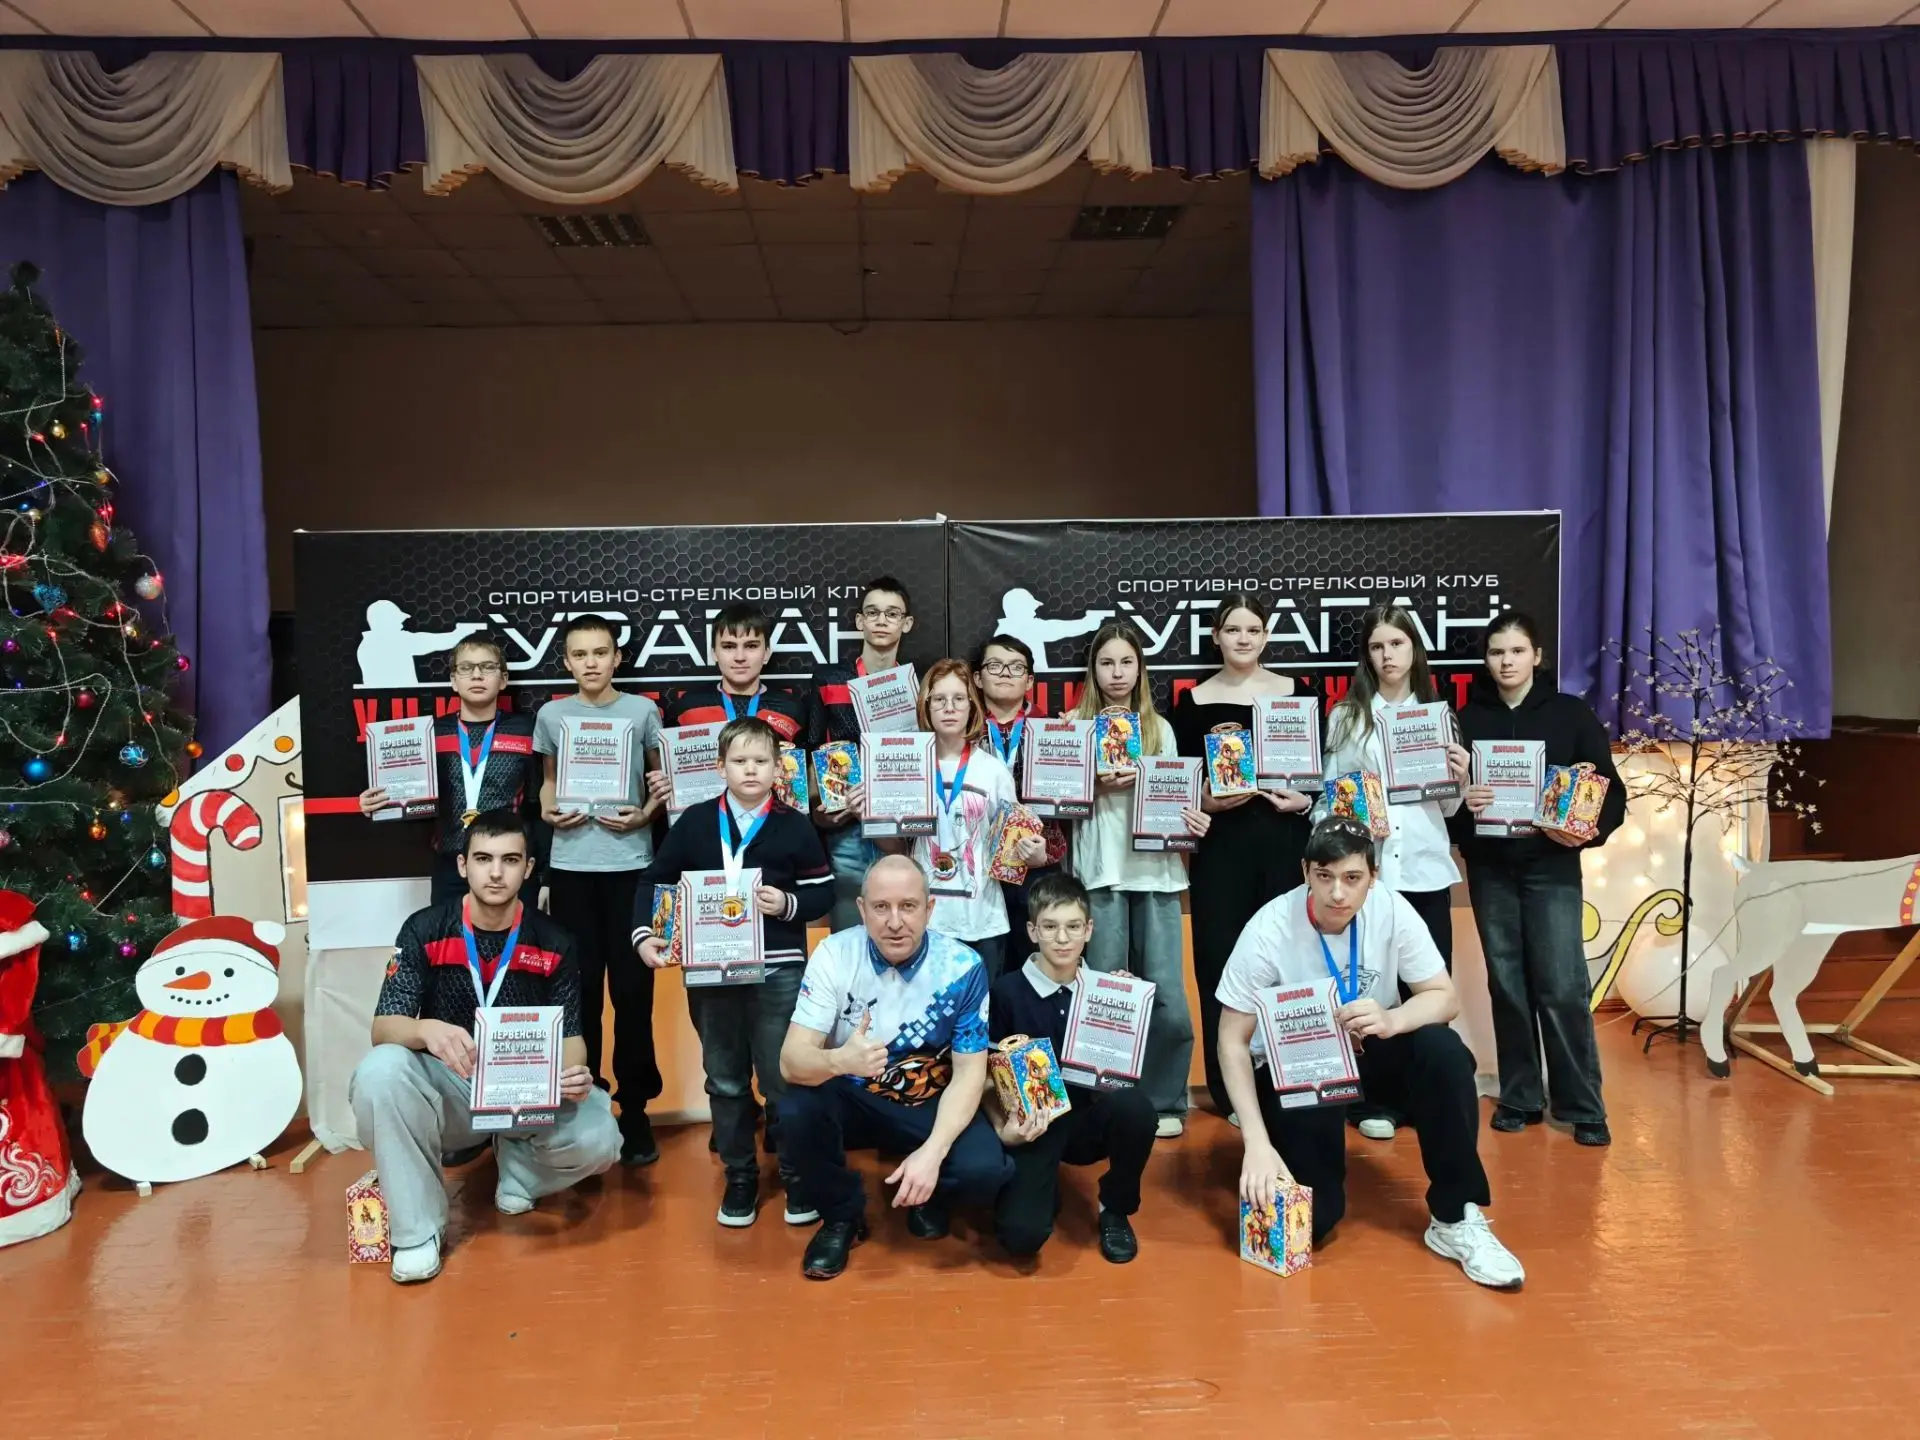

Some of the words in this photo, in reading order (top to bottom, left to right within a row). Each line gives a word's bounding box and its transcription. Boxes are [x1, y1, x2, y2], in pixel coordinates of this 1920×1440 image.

[1117, 574, 1426, 593] СПОРТИВНО-СТРЕЛКОВЫЙ
[1437, 574, 1499, 589] КЛУБ
[488, 584, 816, 606] СПОРТИВНО-СТРЕЛКОВЫЙ
[1392, 723, 1437, 735] ПЕРВЕНСТВО
[379, 737, 422, 749] ПЕРВЕНСТВО
[574, 736, 619, 747] ПЕРВЕНСТВО
[1038, 738, 1082, 747] ПЕРВЕНСТВО
[575, 746, 589, 755] ССК
[673, 742, 719, 755] ПЕРВЕНСТВО
[1040, 747, 1053, 756] ССК
[382, 750, 397, 760] ССК
[677, 754, 693, 765] ССК
[875, 751, 922, 762] ПЕРВЕНСТВО
[878, 763, 893, 772] ССК
[1487, 760, 1532, 769] ПЕРВЕНСТВО
[1148, 773, 1189, 784] ПЕРВЕНСТВО
[1488, 769, 1503, 777] ССК
[699, 903, 717, 914] ССК
[1276, 987, 1314, 1003] ДИПЛОМ
[1087, 993, 1137, 1012] ПЕРВЕНСТВО
[1087, 1003, 1104, 1016] ССК
[1273, 1003, 1327, 1021] ПЕРВЕНСТВО
[500, 1013, 540, 1023] ДИПЛОМ
[1278, 1020, 1297, 1033] ССК
[1299, 1017, 1328, 1031] Ураган
[491, 1029, 548, 1041] ПЕРВЕНСТВО
[493, 1043, 513, 1053] ССК
[515, 1042, 545, 1055] Ураган
